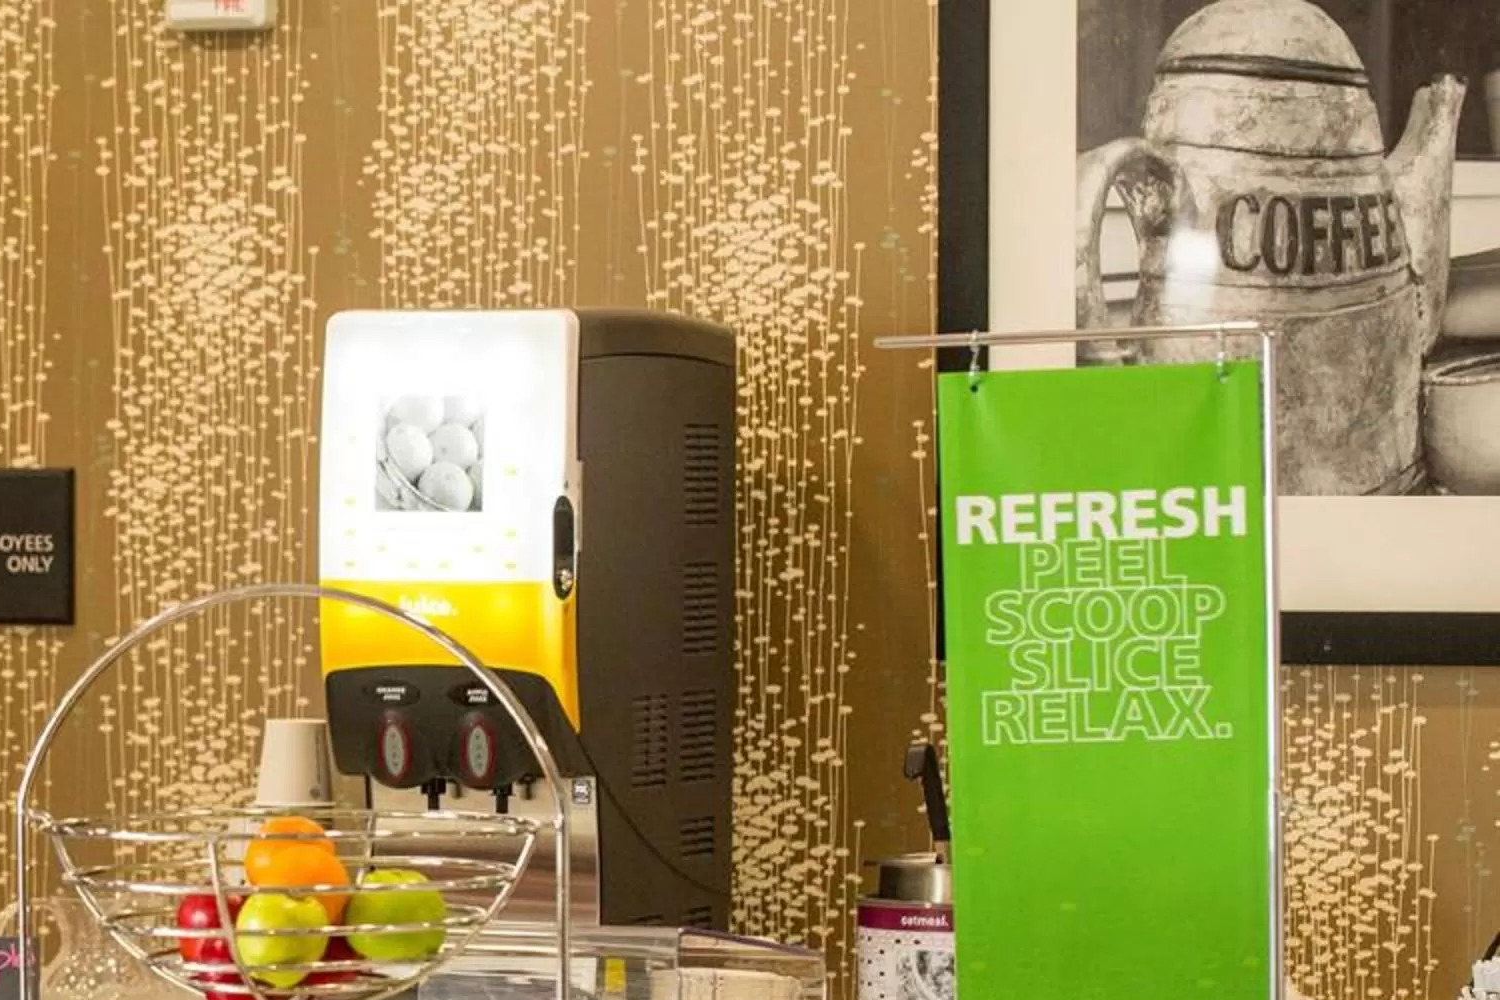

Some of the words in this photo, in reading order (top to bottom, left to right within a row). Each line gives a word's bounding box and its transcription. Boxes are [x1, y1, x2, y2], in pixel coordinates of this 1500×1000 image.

[1216, 193, 1401, 277] COFFEE
[956, 486, 1247, 544] REFRESH
[6, 556, 54, 573] ONLY
[1020, 537, 1188, 593] PEEL
[985, 584, 1227, 645] SCOOP
[1009, 634, 1204, 695] SLICE
[980, 686, 1234, 746] RELAX.
